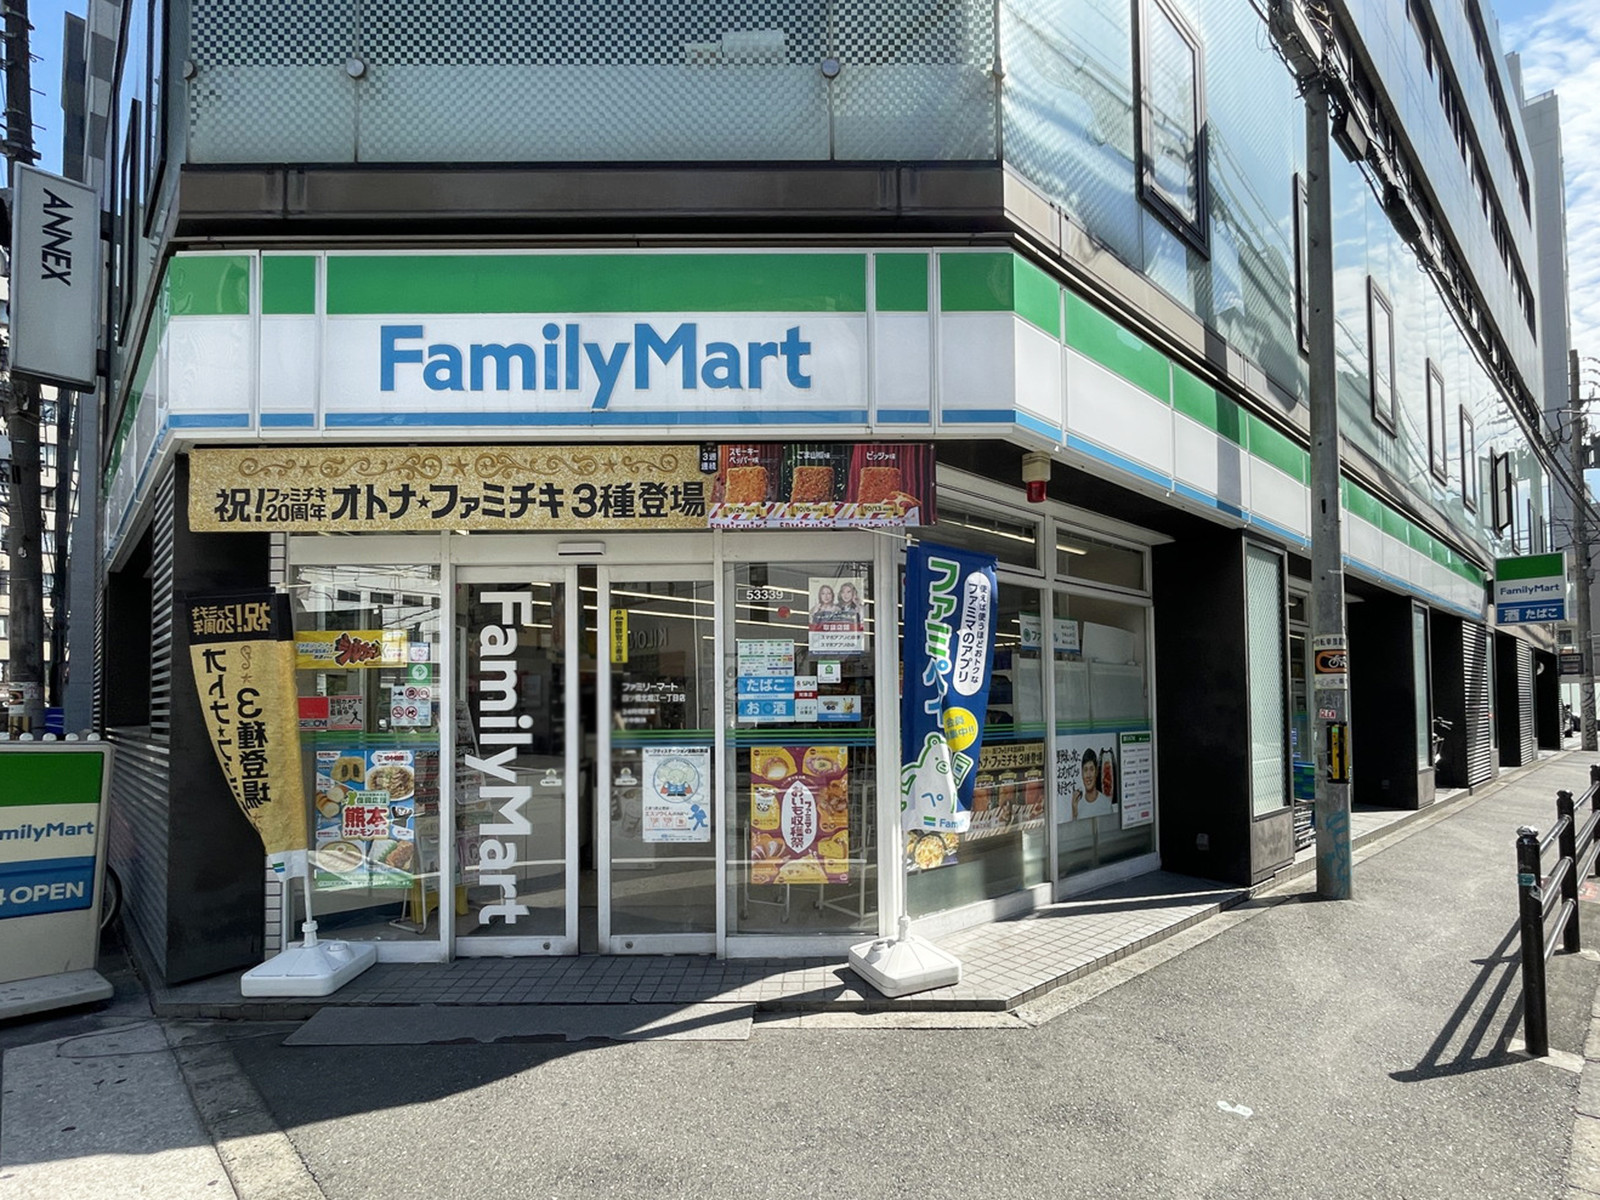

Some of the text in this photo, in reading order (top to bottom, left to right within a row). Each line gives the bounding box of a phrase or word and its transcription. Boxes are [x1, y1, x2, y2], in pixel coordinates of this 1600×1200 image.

[42, 187, 73, 286] ANNEX
[380, 323, 812, 410] FamilyMart
[266, 487, 327, 503] ファミチキ
[265, 503, 327, 522] 20周年
[746, 589, 784, 600] 53339
[1500, 584, 1560, 595] FamilyMart
[1503, 608, 1558, 622] 酒 たばこ
[959, 583, 978, 683] ファミマのアプリ
[970, 584, 988, 683] 使えば使うほどおトクな
[621, 682, 679, 692] ファミリーマート
[746, 679, 787, 692] たばこ
[465, 591, 534, 925] FamilyMart
[344, 806, 388, 828] 熊本
